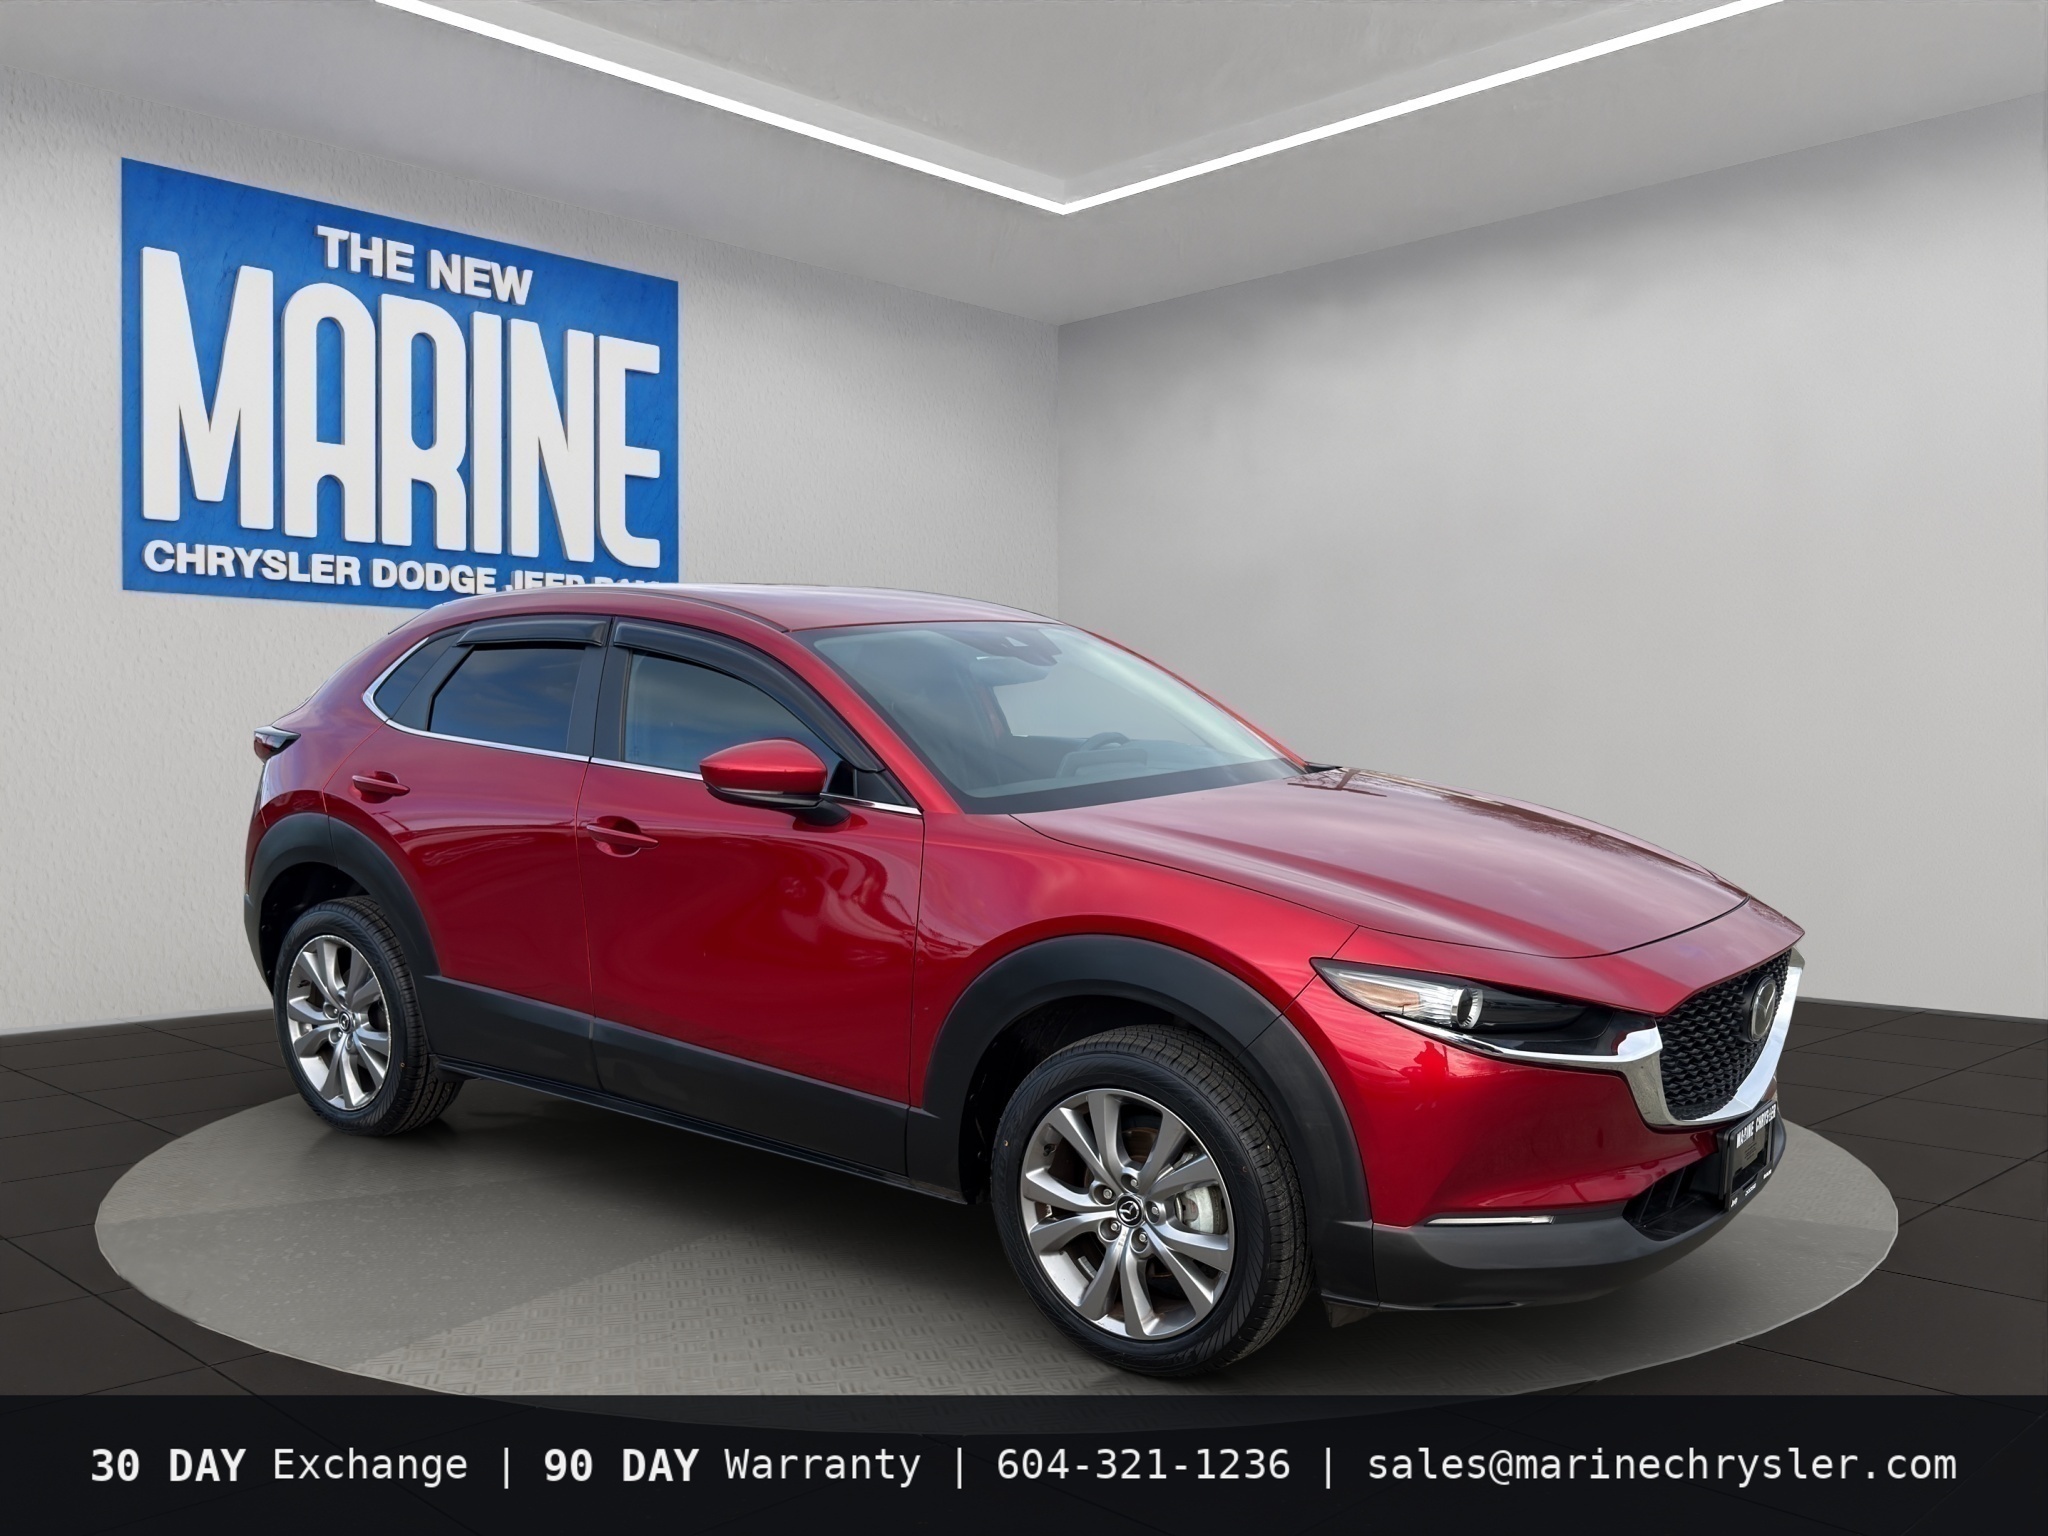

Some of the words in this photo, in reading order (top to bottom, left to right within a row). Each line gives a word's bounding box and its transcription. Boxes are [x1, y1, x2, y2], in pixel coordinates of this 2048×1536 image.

[316, 225, 415, 284] THE
[427, 250, 533, 306] NEW
[140, 246, 661, 569] MARINE
[142, 539, 361, 587] CHRYSLER
[371, 558, 497, 595] DODGE
